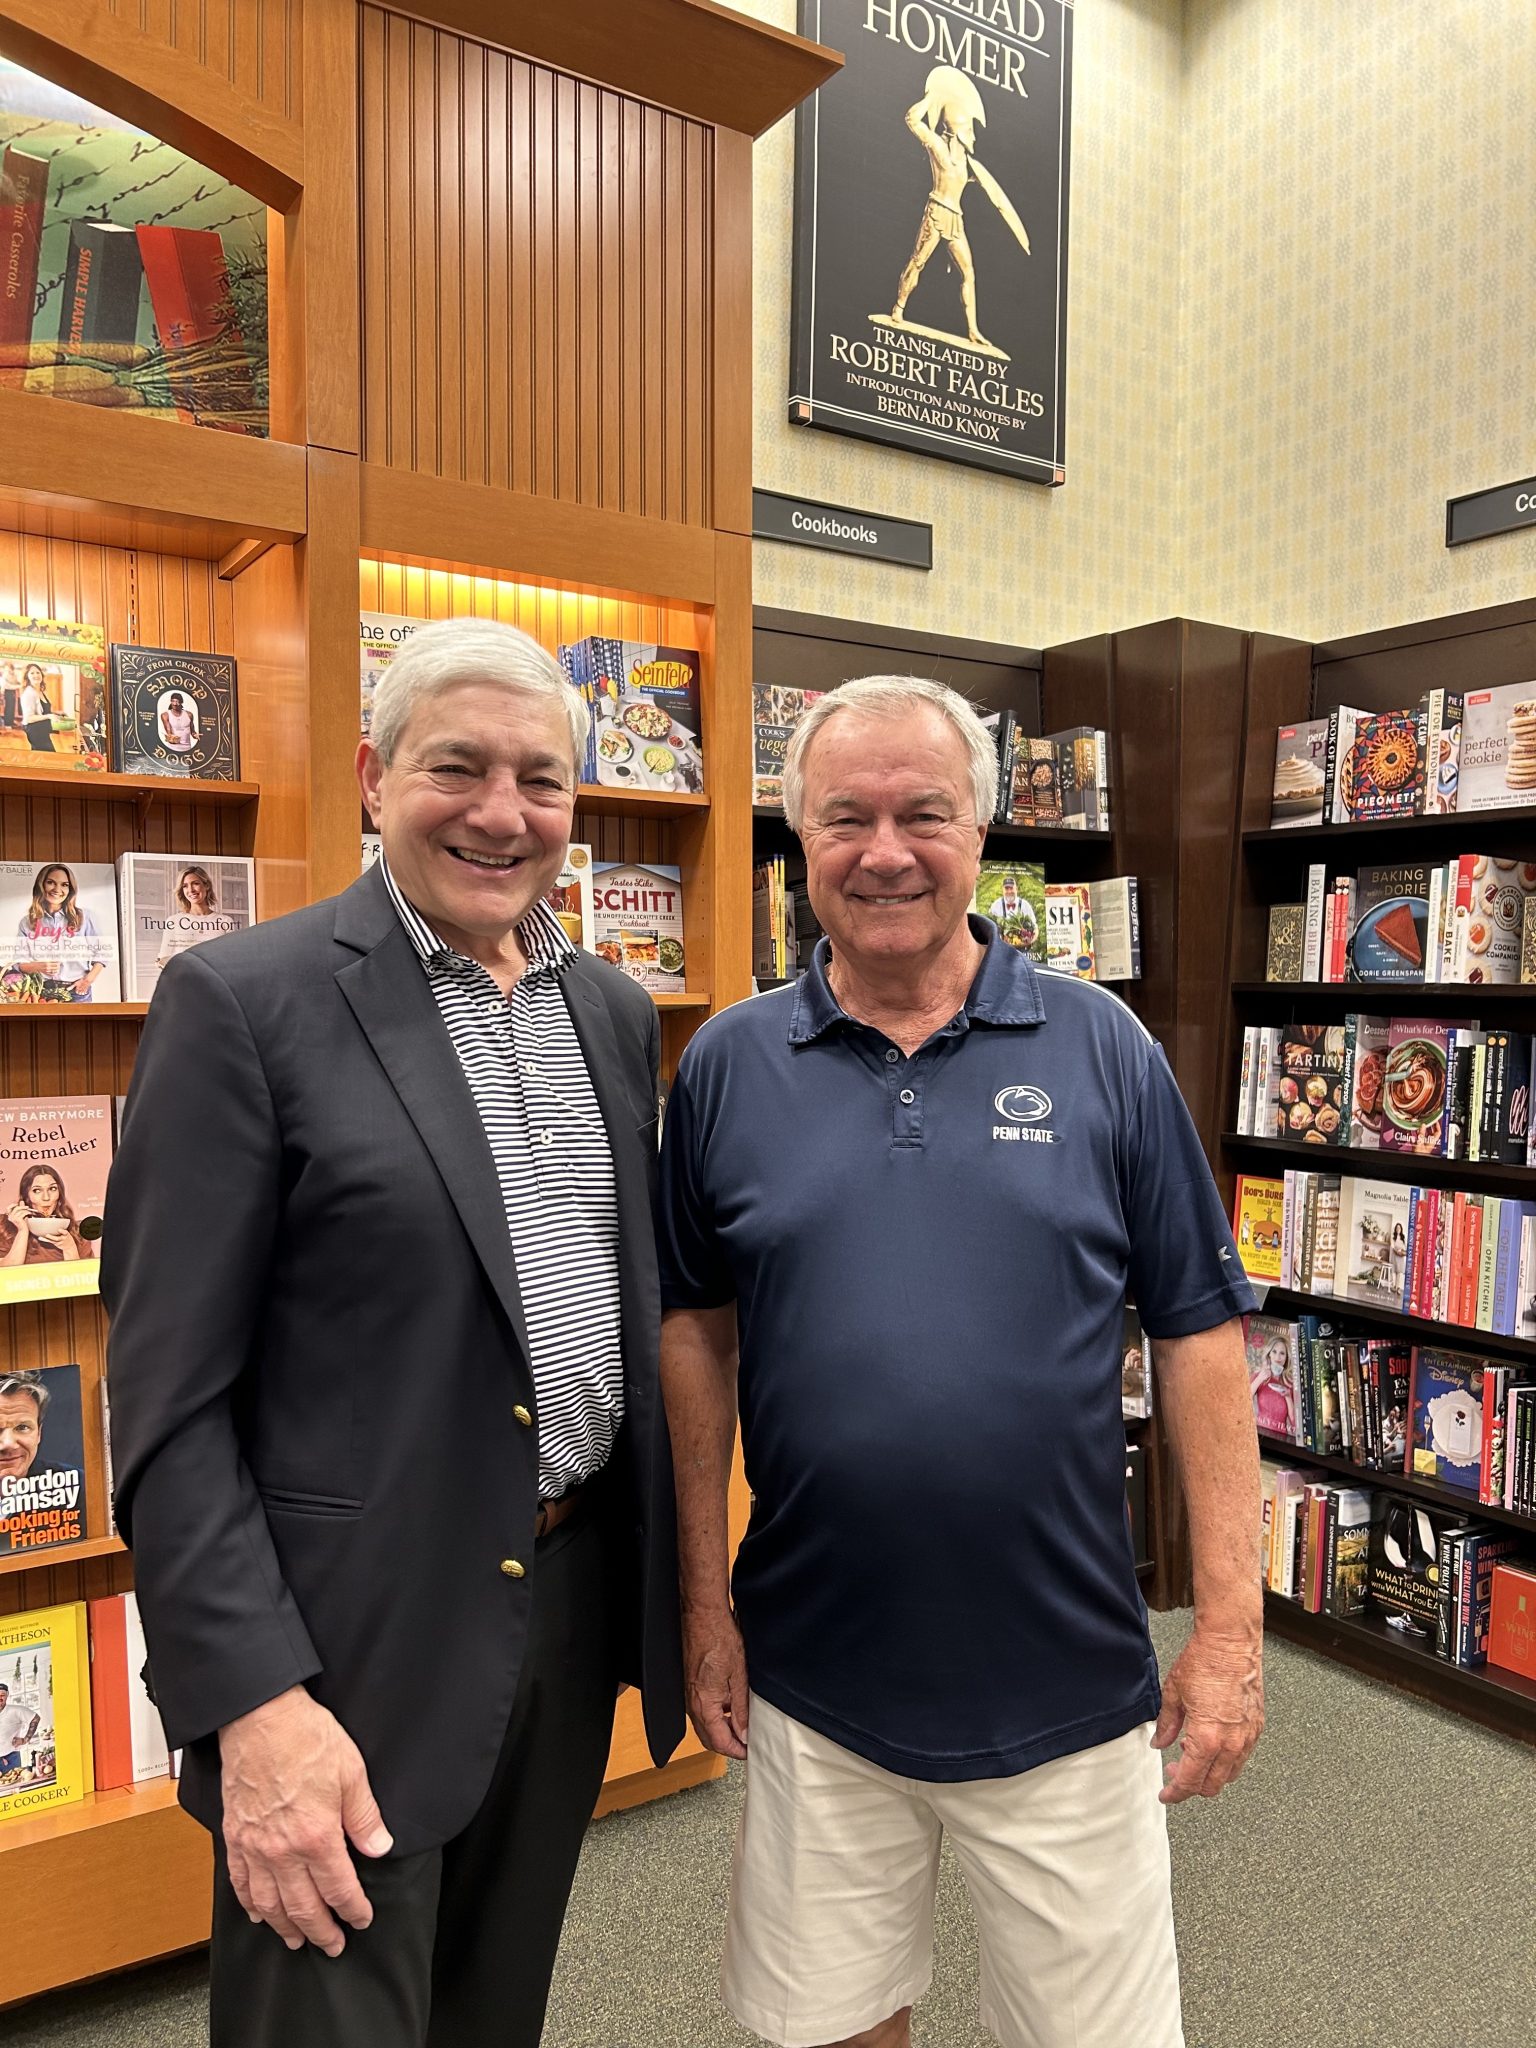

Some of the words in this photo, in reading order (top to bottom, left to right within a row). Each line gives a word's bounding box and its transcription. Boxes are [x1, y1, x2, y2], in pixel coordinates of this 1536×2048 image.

[862, 0, 1028, 98] HOMER
[13, 175, 30, 229] Favorite
[6, 231, 25, 299] Casseroles
[75, 247, 93, 295] SIMPLE
[873, 326, 985, 373] TRANSLATED
[987, 360, 1008, 379] BY
[829, 334, 941, 388] ROBERT
[947, 368, 1045, 417] FAGLES
[846, 372, 943, 408] INTRODUCTION
[944, 399, 971, 415] AND
[973, 408, 1011, 426] NOTES
[1012, 418, 1027, 430] BY
[877, 395, 954, 429] BERNARD
[955, 416, 1000, 442] KNOX
[791, 511, 878, 544] Cookbooks
[147, 660, 173, 672] FROM
[175, 660, 207, 677] CROOK
[632, 658, 691, 689] Seinfeld
[146, 674, 208, 699] SNOOP
[1328, 712, 1338, 743] BOOK
[1418, 712, 1428, 727] PIE
[1432, 712, 1440, 732] FOR
[1418, 728, 1428, 746] CAMP
[1464, 737, 1508, 754] perfect
[152, 745, 206, 767] DOGG
[1327, 747, 1336, 761] OF
[1429, 733, 1439, 780] EVERYONE
[1463, 751, 1502, 766] cookie
[1326, 763, 1334, 780] PIE
[6, 866, 33, 874] BAUER
[1372, 869, 1424, 883] BAKING
[609, 877, 633, 887] Tastes
[633, 877, 654, 888] Like
[1384, 883, 1427, 896] DORIE
[593, 889, 676, 913] SCHITT
[1309, 879, 1320, 927] BAKING
[1448, 883, 1456, 927] HOLLYWOOD
[141, 916, 175, 931] True
[179, 916, 242, 931] Comfort
[618, 919, 651, 928] Cookbook
[1049, 906, 1074, 926] SH
[28, 917, 76, 943] Joy's
[63, 939, 113, 952] Remedies
[1306, 930, 1317, 968] BIBLE
[1443, 931, 1453, 964] BAKE
[1493, 943, 1517, 952] COOKIE
[631, 967, 641, 977] 75
[1396, 1024, 1421, 1035] What's
[1422, 1024, 1433, 1034] for
[1344, 1047, 1352, 1078] Dessert
[1343, 1078, 1351, 1105] Person
[20, 1109, 104, 1122] BARRYMORE
[11, 1124, 66, 1143] Rebel
[992, 1126, 1020, 1140] PENN
[1021, 1127, 1054, 1143] STATE
[0, 1138, 97, 1160] omemaker
[1243, 1186, 1264, 1198] BOB'S
[1364, 1190, 1392, 1202] Magnolia
[1393, 1193, 1409, 1203] Table
[1428, 1231, 1433, 1239] TO
[1470, 1236, 1475, 1245] on
[1500, 1228, 1509, 1252] FOR
[1498, 1258, 1507, 1278] THE
[1481, 1275, 1490, 1313] KITCHEN
[1495, 1281, 1506, 1317] TABLE
[1424, 1357, 1472, 1372] ENTERTAINING
[1427, 1366, 1465, 1390] Disney
[2, 1468, 80, 1497] Gordon
[0, 1485, 81, 1516] amsay
[0, 1509, 61, 1534] ooking
[61, 1509, 81, 1523] for
[10, 1522, 81, 1549] Friends
[1442, 1544, 1450, 1566] WINE
[1326, 1575, 1332, 1583] OF
[1375, 1568, 1404, 1585] WHAT
[1404, 1581, 1412, 1590] TO
[1441, 1566, 1450, 1591] FOLLY
[1462, 1559, 1472, 1604] SPARKLING
[1371, 1580, 1386, 1591] WITH
[1385, 1583, 1414, 1601] WHAT
[1414, 1596, 1427, 1607] YOU
[1461, 1604, 1470, 1627] WINE
[1505, 1621, 1536, 1641] WINE
[14, 1785, 71, 1809] COOKERY
